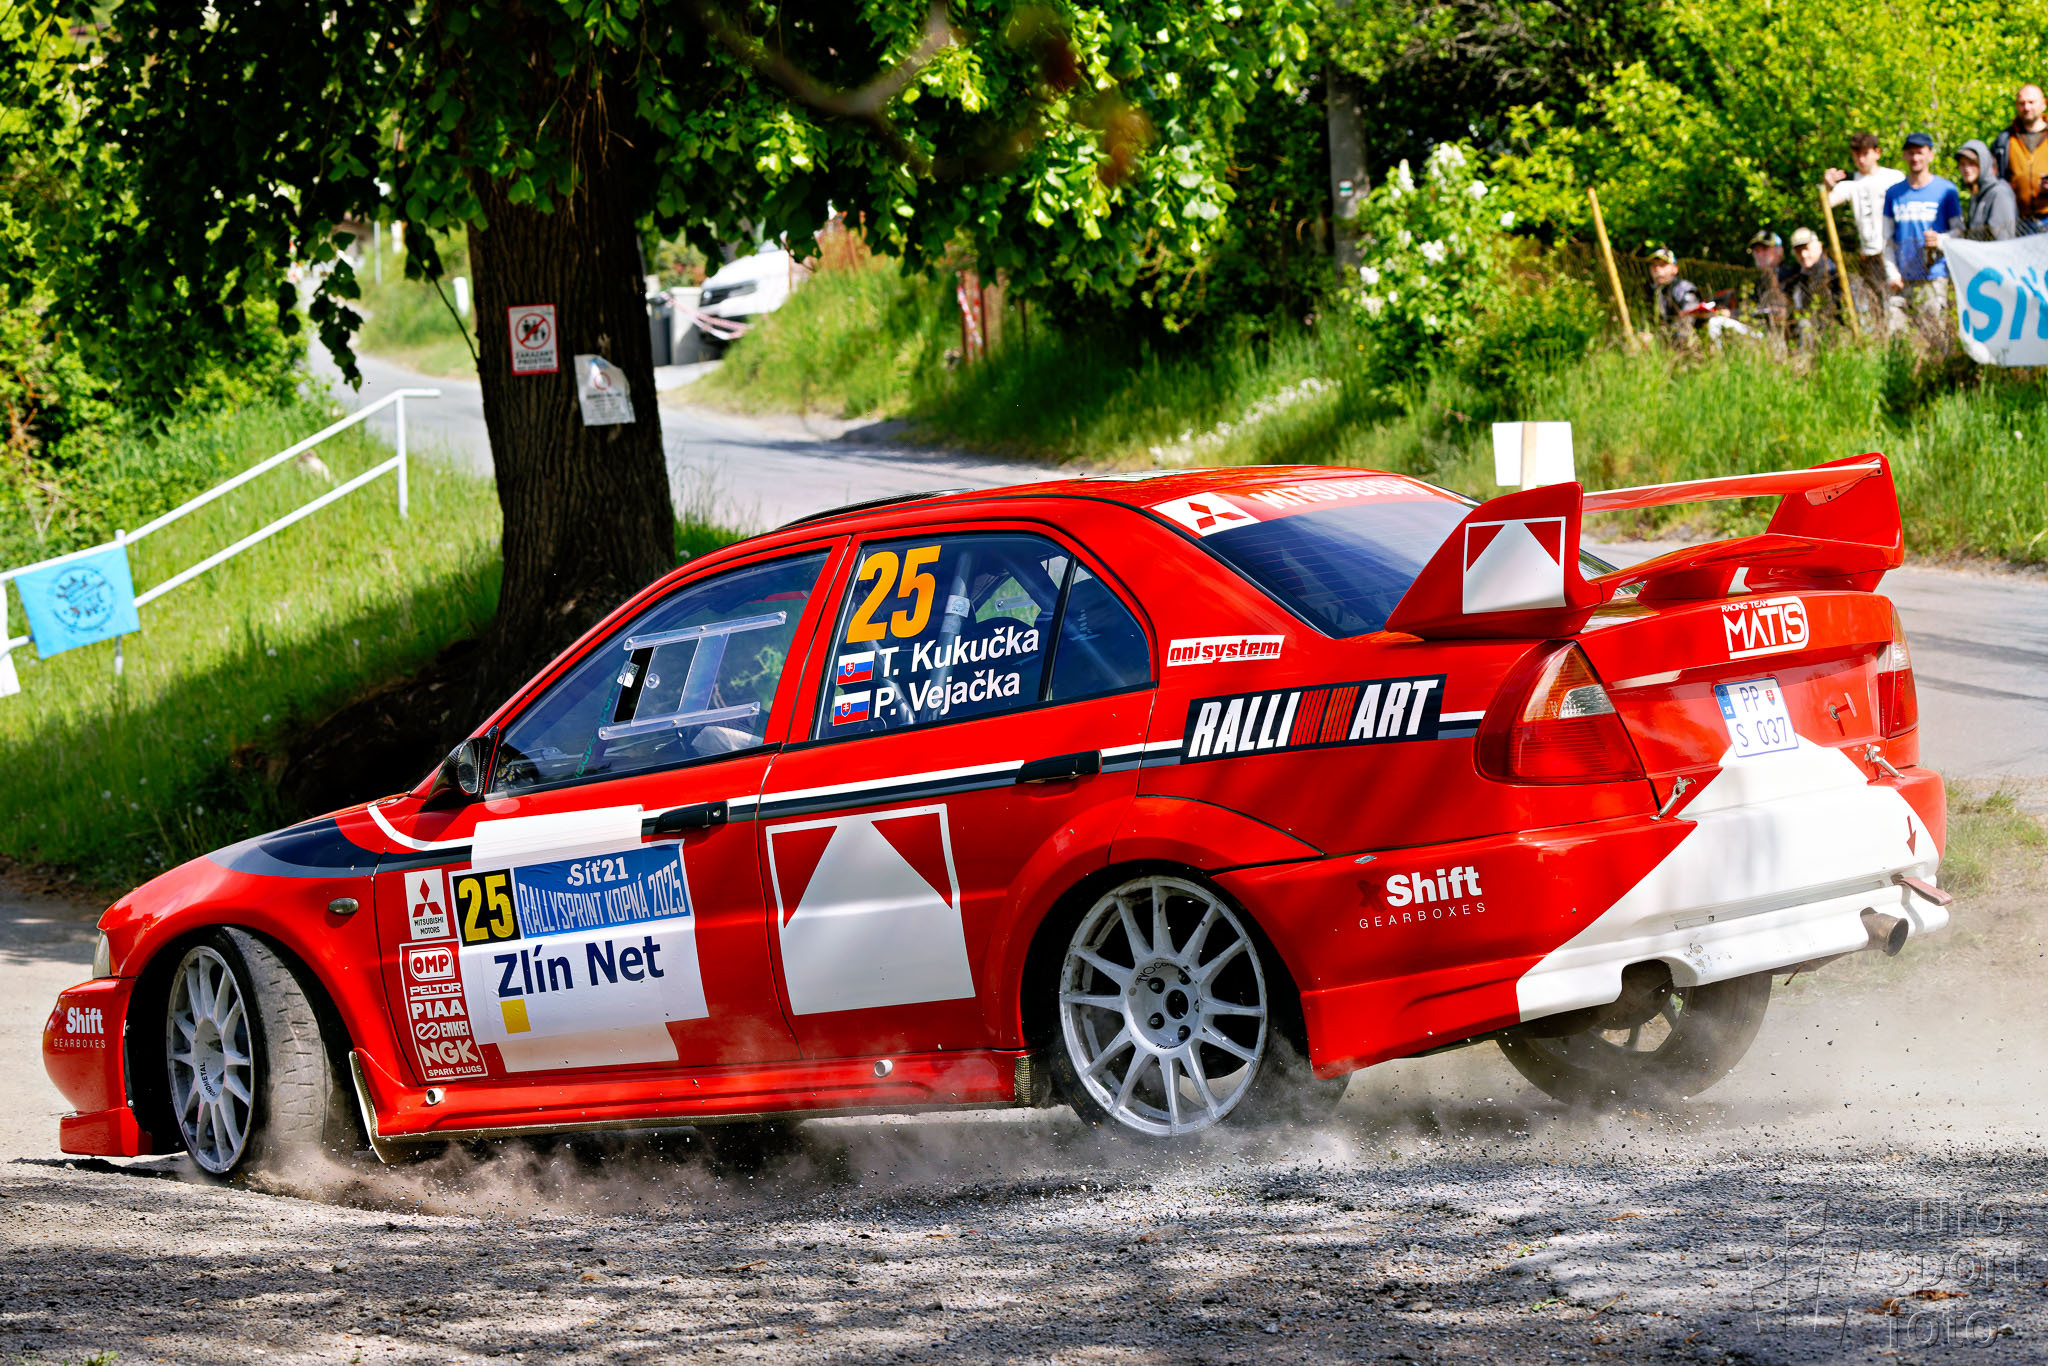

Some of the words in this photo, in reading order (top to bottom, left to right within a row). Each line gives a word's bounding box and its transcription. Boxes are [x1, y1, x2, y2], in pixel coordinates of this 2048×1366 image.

[1248, 480, 1435, 510] MITSUBISHI
[846, 545, 942, 644] 25
[1721, 601, 1748, 612] RACING
[1749, 599, 1769, 609] TEAM
[1722, 603, 1807, 652] MATIS
[878, 646, 900, 678] T.
[911, 625, 1040, 673] Kukučka
[874, 686, 897, 719] P.
[908, 668, 1021, 716] Vejačka
[1739, 685, 1760, 713] PP
[1348, 679, 1439, 741] ART
[1736, 723, 1750, 748] S
[1756, 716, 1788, 746] 037
[458, 873, 515, 942] 25
[518, 882, 605, 935] RALLYSPRINT
[604, 872, 651, 923] KOPNÁ
[647, 859, 686, 918] 2025
[414, 916, 444, 926] MITSUBISHI
[1359, 902, 1486, 929] GEARBOXES
[420, 926, 441, 935] MOTORS
[413, 953, 449, 974] OMP
[494, 944, 574, 998] Zlín
[585, 936, 664, 987] Net
[409, 982, 462, 996] PELTOR
[66, 1006, 105, 1034] Shift
[410, 999, 466, 1020] PIAA
[440, 1020, 470, 1038] ENKEI
[53, 1038, 106, 1049] GEARBOXES
[418, 1038, 479, 1067] NGK
[427, 1066, 455, 1077] SPARK
[456, 1065, 483, 1075] PLUGS
